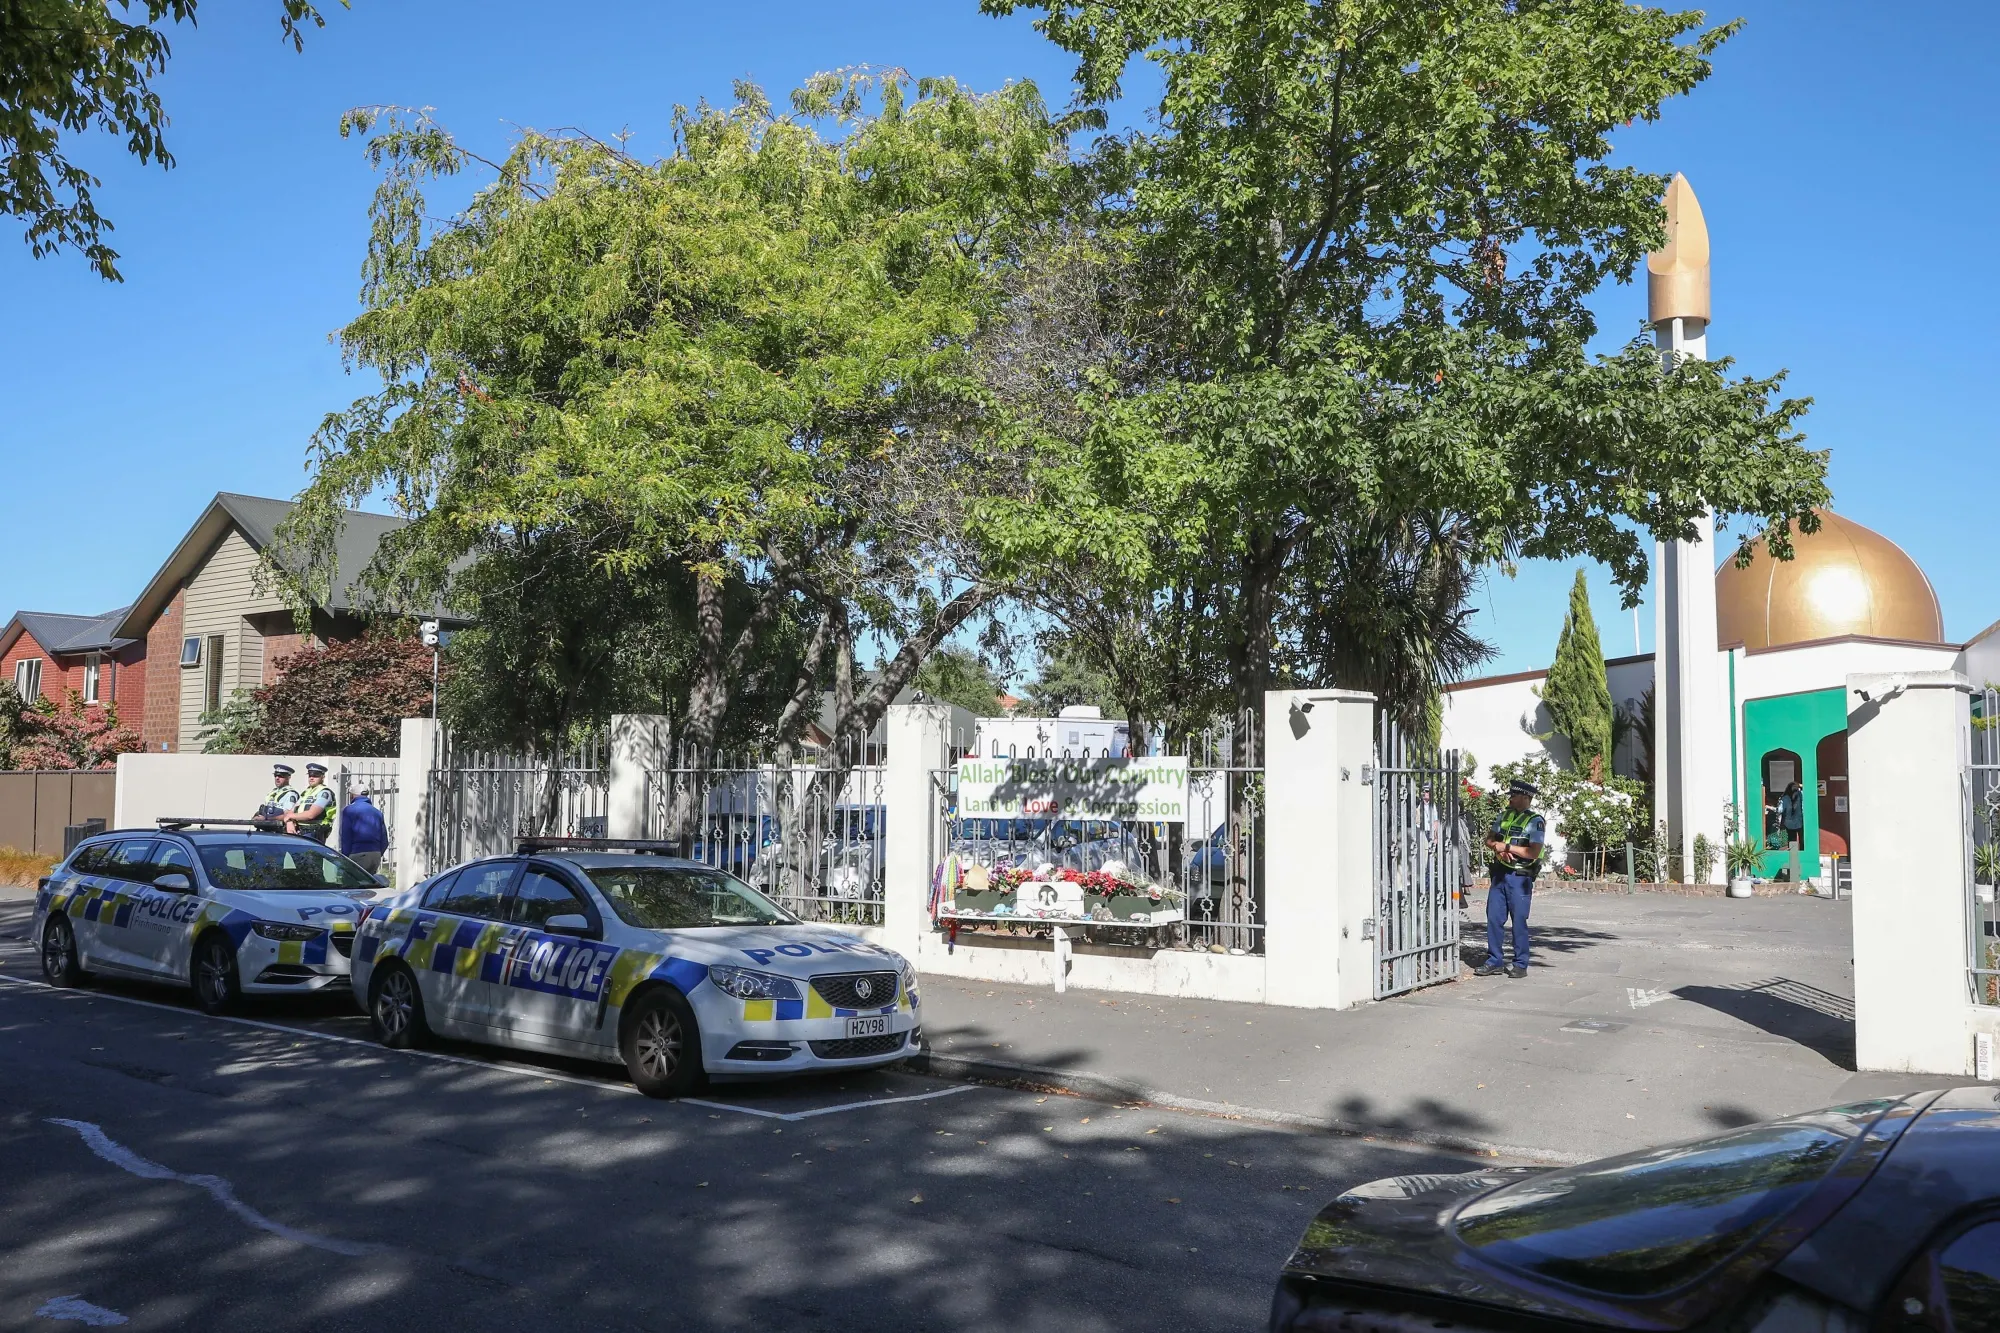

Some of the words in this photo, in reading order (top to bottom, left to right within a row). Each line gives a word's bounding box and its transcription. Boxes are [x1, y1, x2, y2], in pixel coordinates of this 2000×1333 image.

[960, 764, 1005, 783] Allah
[1011, 764, 1057, 784] Bless
[1064, 763, 1099, 784] Our
[1105, 764, 1186, 788] Country
[965, 797, 999, 812] Land
[1004, 795, 1020, 812] of
[1024, 798, 1058, 813] Love
[1064, 797, 1077, 815] &
[1081, 798, 1181, 817] Compassion
[138, 894, 199, 923] POLICE
[741, 940, 891, 966] POLICE
[513, 939, 613, 993] POLICE
[851, 1019, 885, 1035] HZY98
